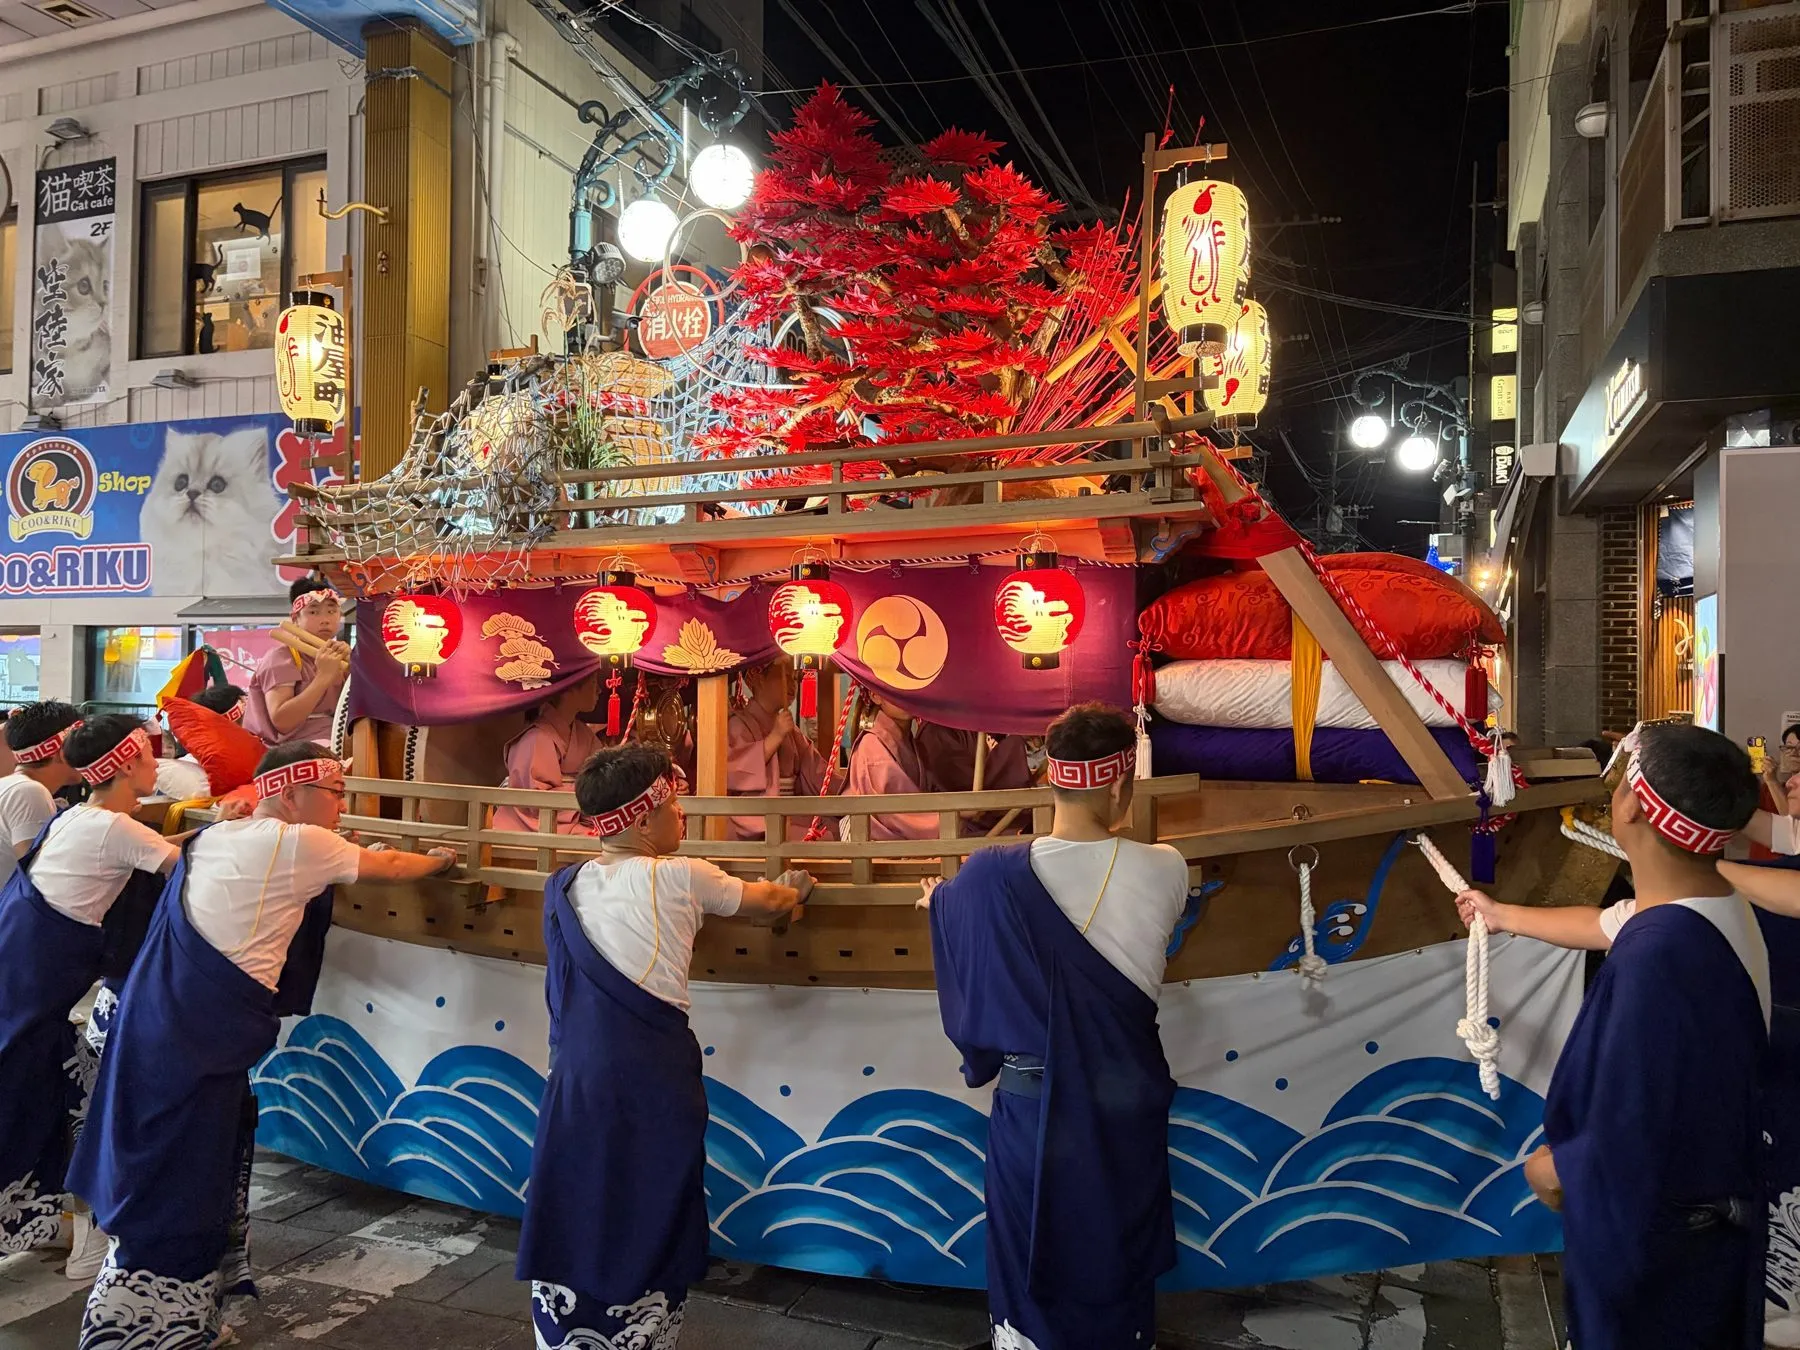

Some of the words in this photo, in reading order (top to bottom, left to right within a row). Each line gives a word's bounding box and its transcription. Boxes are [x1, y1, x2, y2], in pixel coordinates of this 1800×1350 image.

[39, 165, 115, 217] 猫喫茶
[70, 198, 89, 212] Cat
[90, 195, 114, 208] cafe
[90, 220, 113, 237] 2F
[645, 306, 704, 341] 消火栓
[98, 471, 152, 495] Shop
[20, 513, 80, 531] COO&RIKU
[0, 549, 148, 588] O&RIKU
